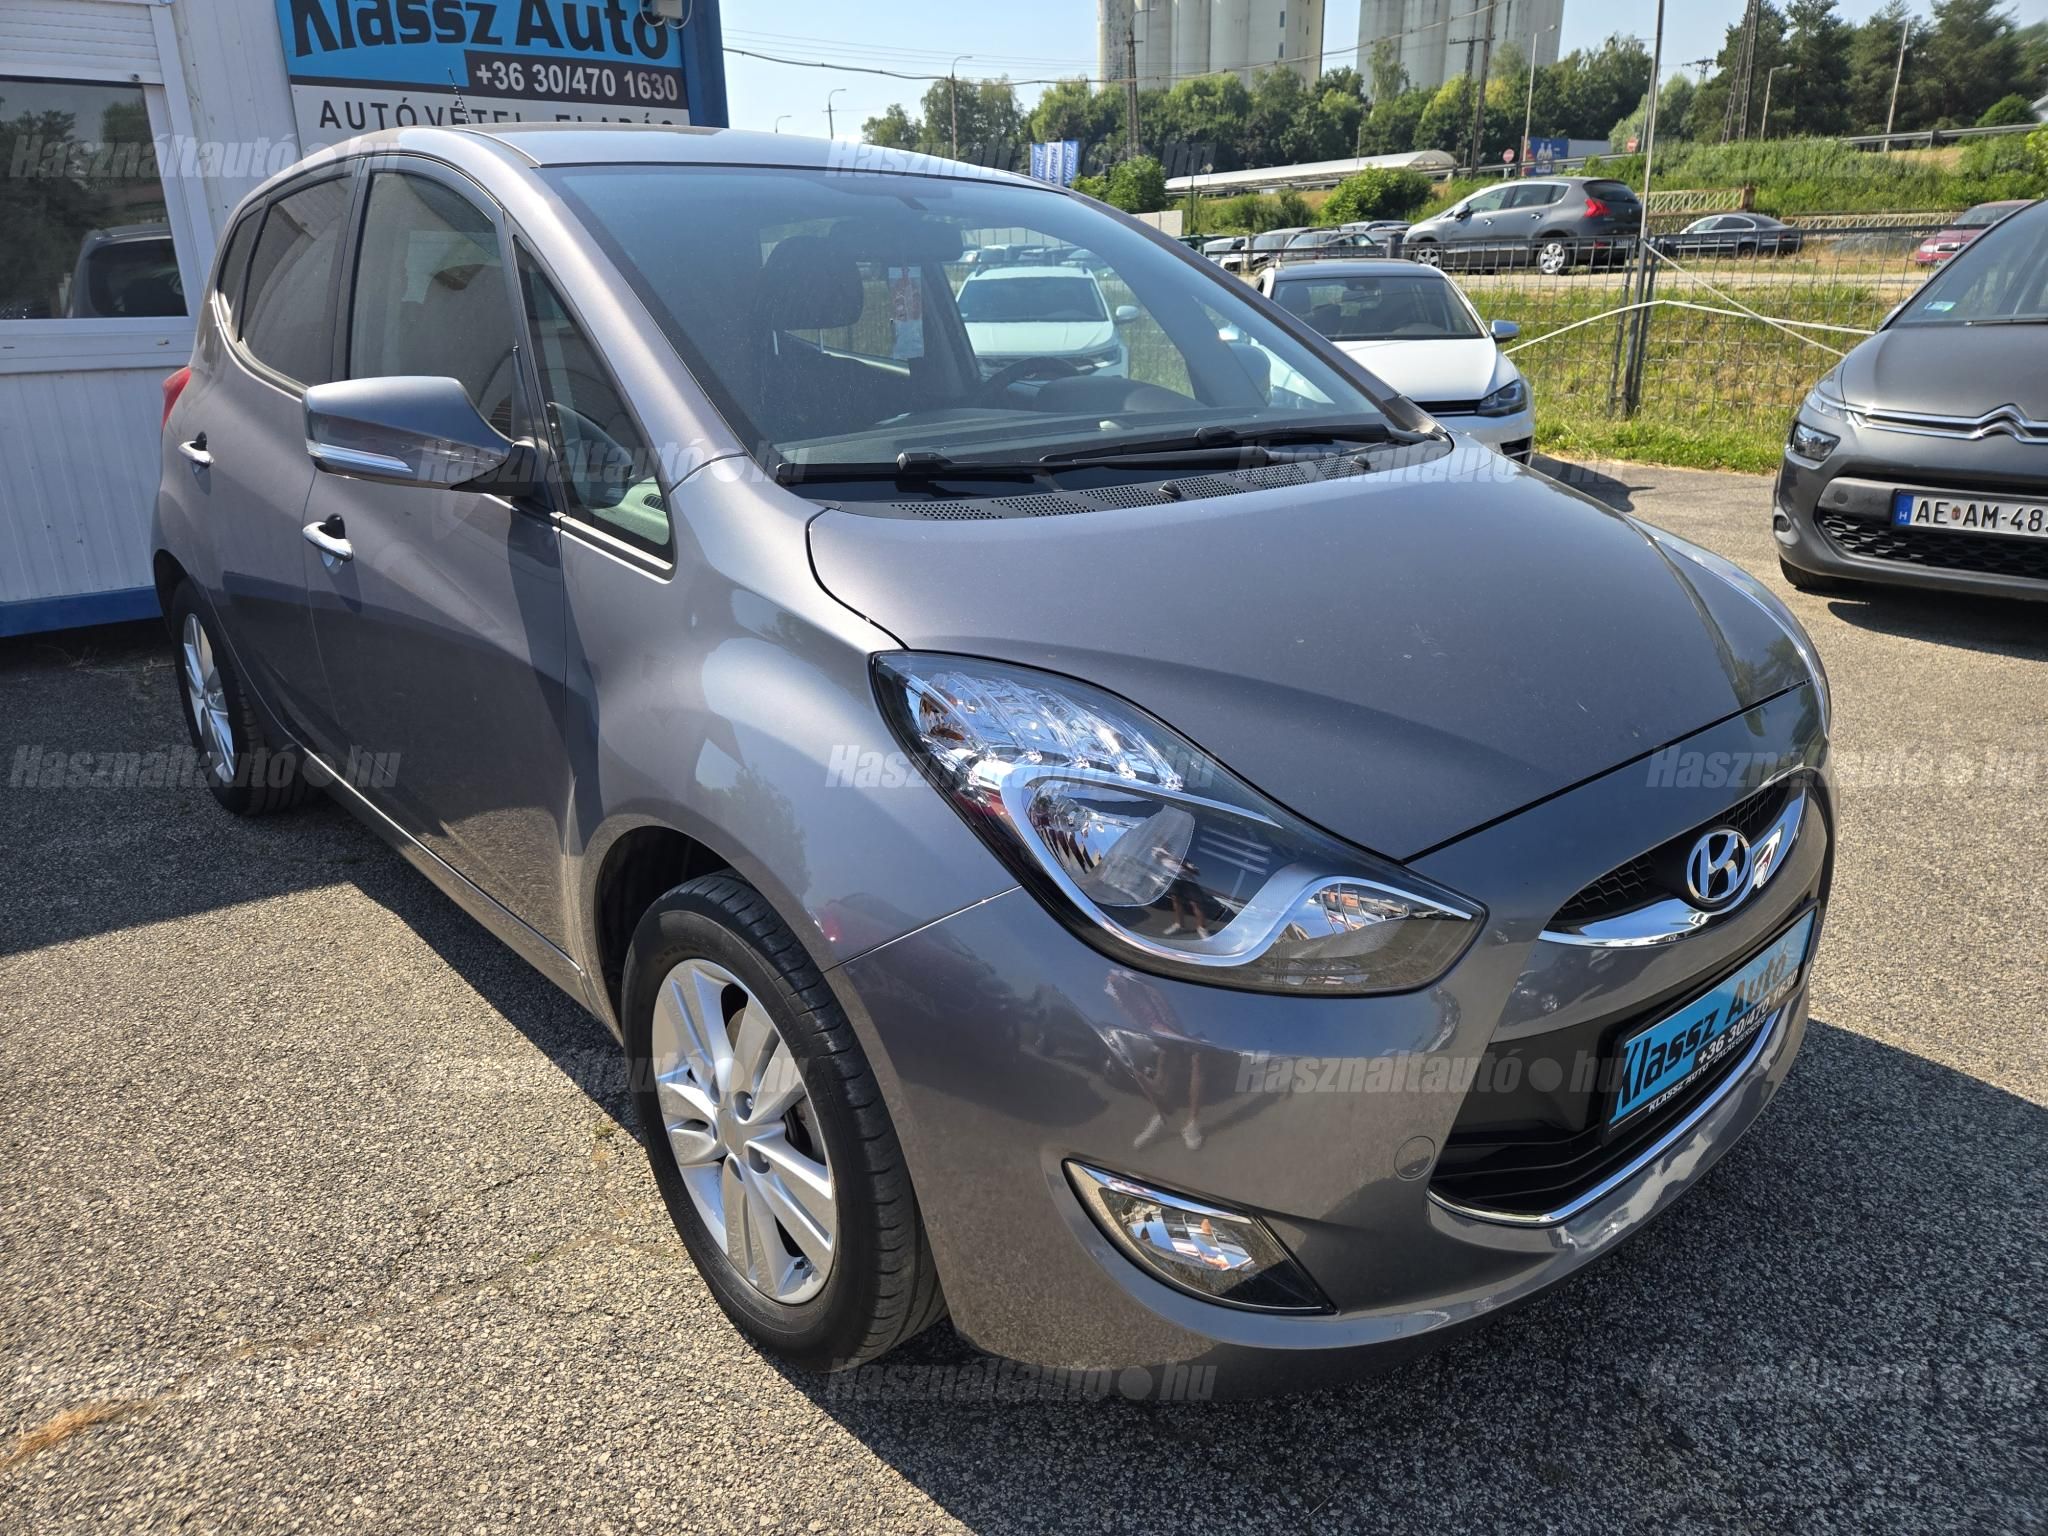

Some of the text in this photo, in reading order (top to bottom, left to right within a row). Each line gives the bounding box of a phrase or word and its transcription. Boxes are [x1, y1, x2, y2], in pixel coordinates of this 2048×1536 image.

[476, 61, 678, 101] +36 30/470 1630
[1915, 500, 2048, 533] AE AM-48
[1699, 968, 1798, 1064] +36 30/470 1630
[1620, 1008, 1720, 1109] Klassz
